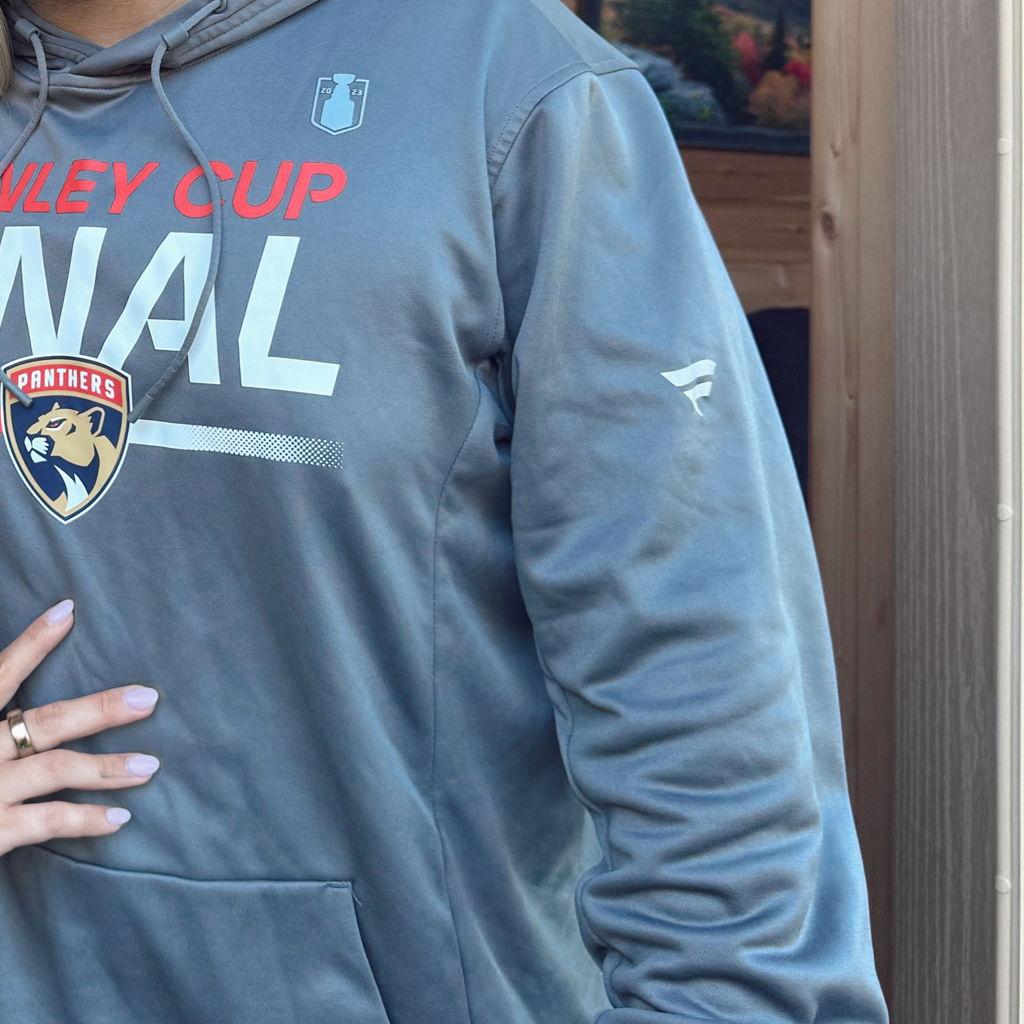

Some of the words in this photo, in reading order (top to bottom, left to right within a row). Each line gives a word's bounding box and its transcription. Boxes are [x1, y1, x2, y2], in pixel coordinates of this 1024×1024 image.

[320, 87, 332, 95] 20
[351, 88, 363, 96] 23
[174, 160, 348, 220] CUP
[17, 367, 115, 400] PANTHERS
